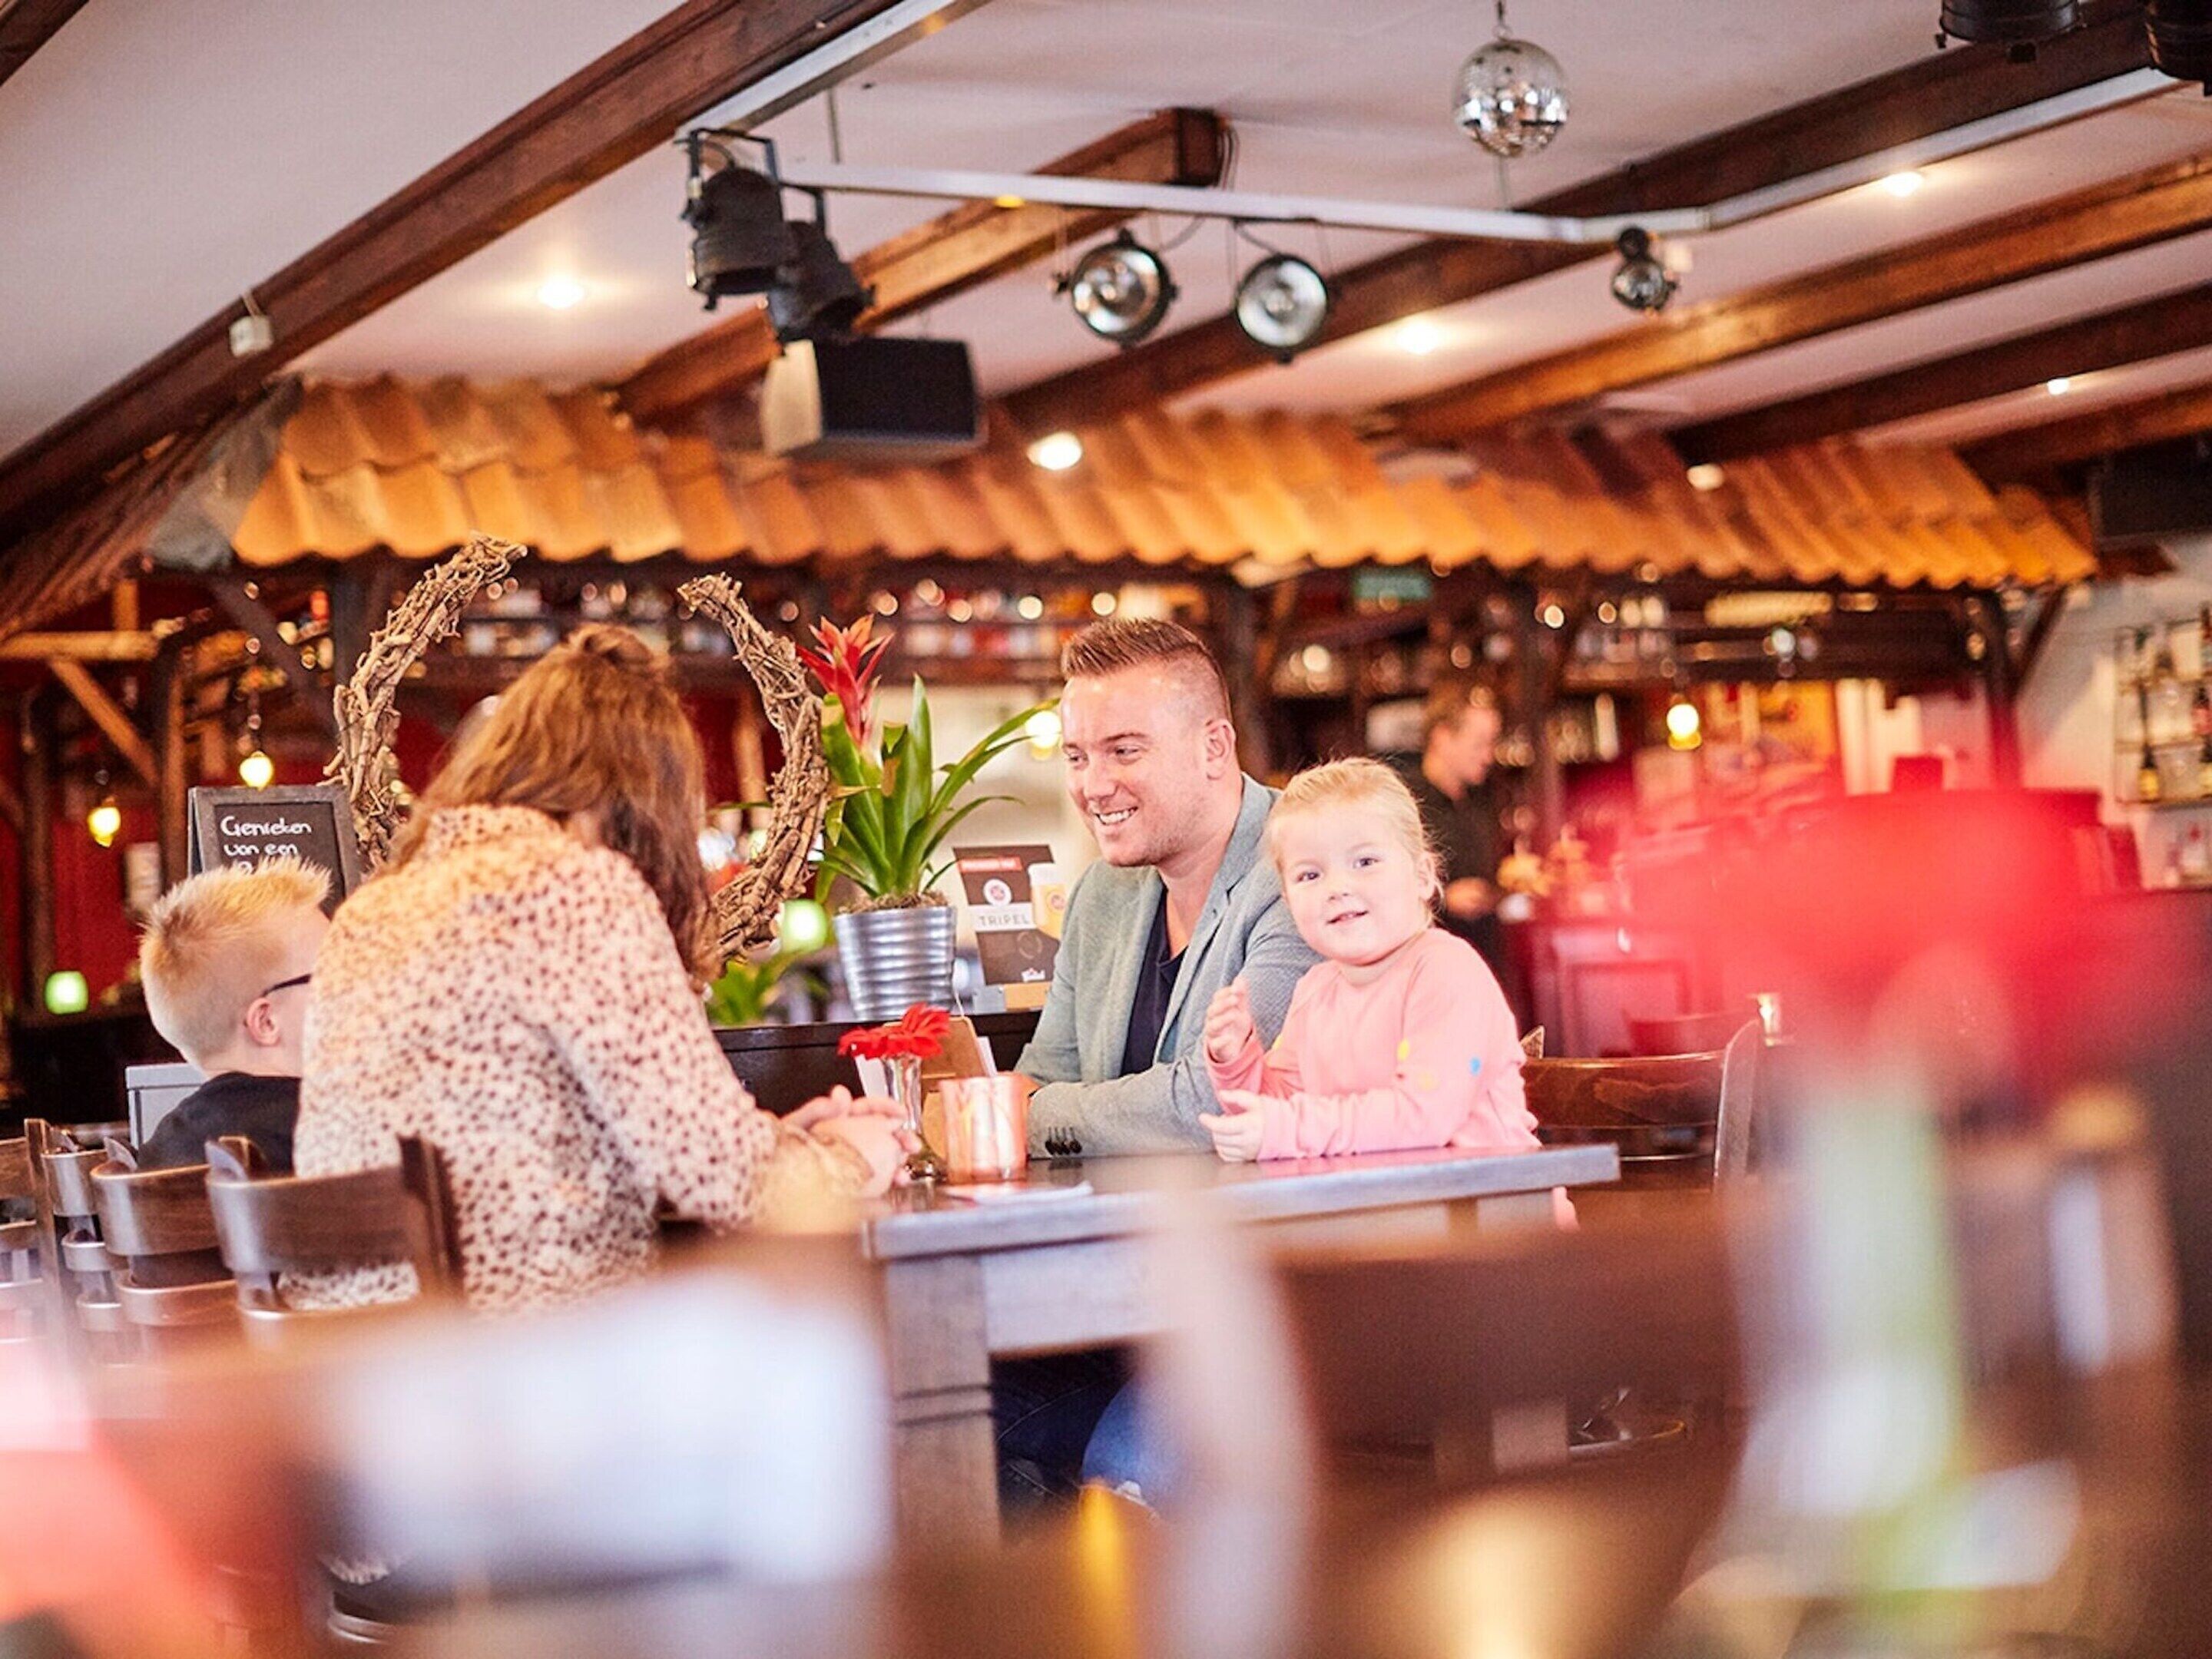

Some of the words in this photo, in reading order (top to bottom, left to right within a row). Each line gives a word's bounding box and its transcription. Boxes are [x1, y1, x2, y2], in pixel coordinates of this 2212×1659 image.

[224, 843, 260, 856] van
[264, 843, 298, 856] een
[979, 915, 1029, 927] TRIPEL
